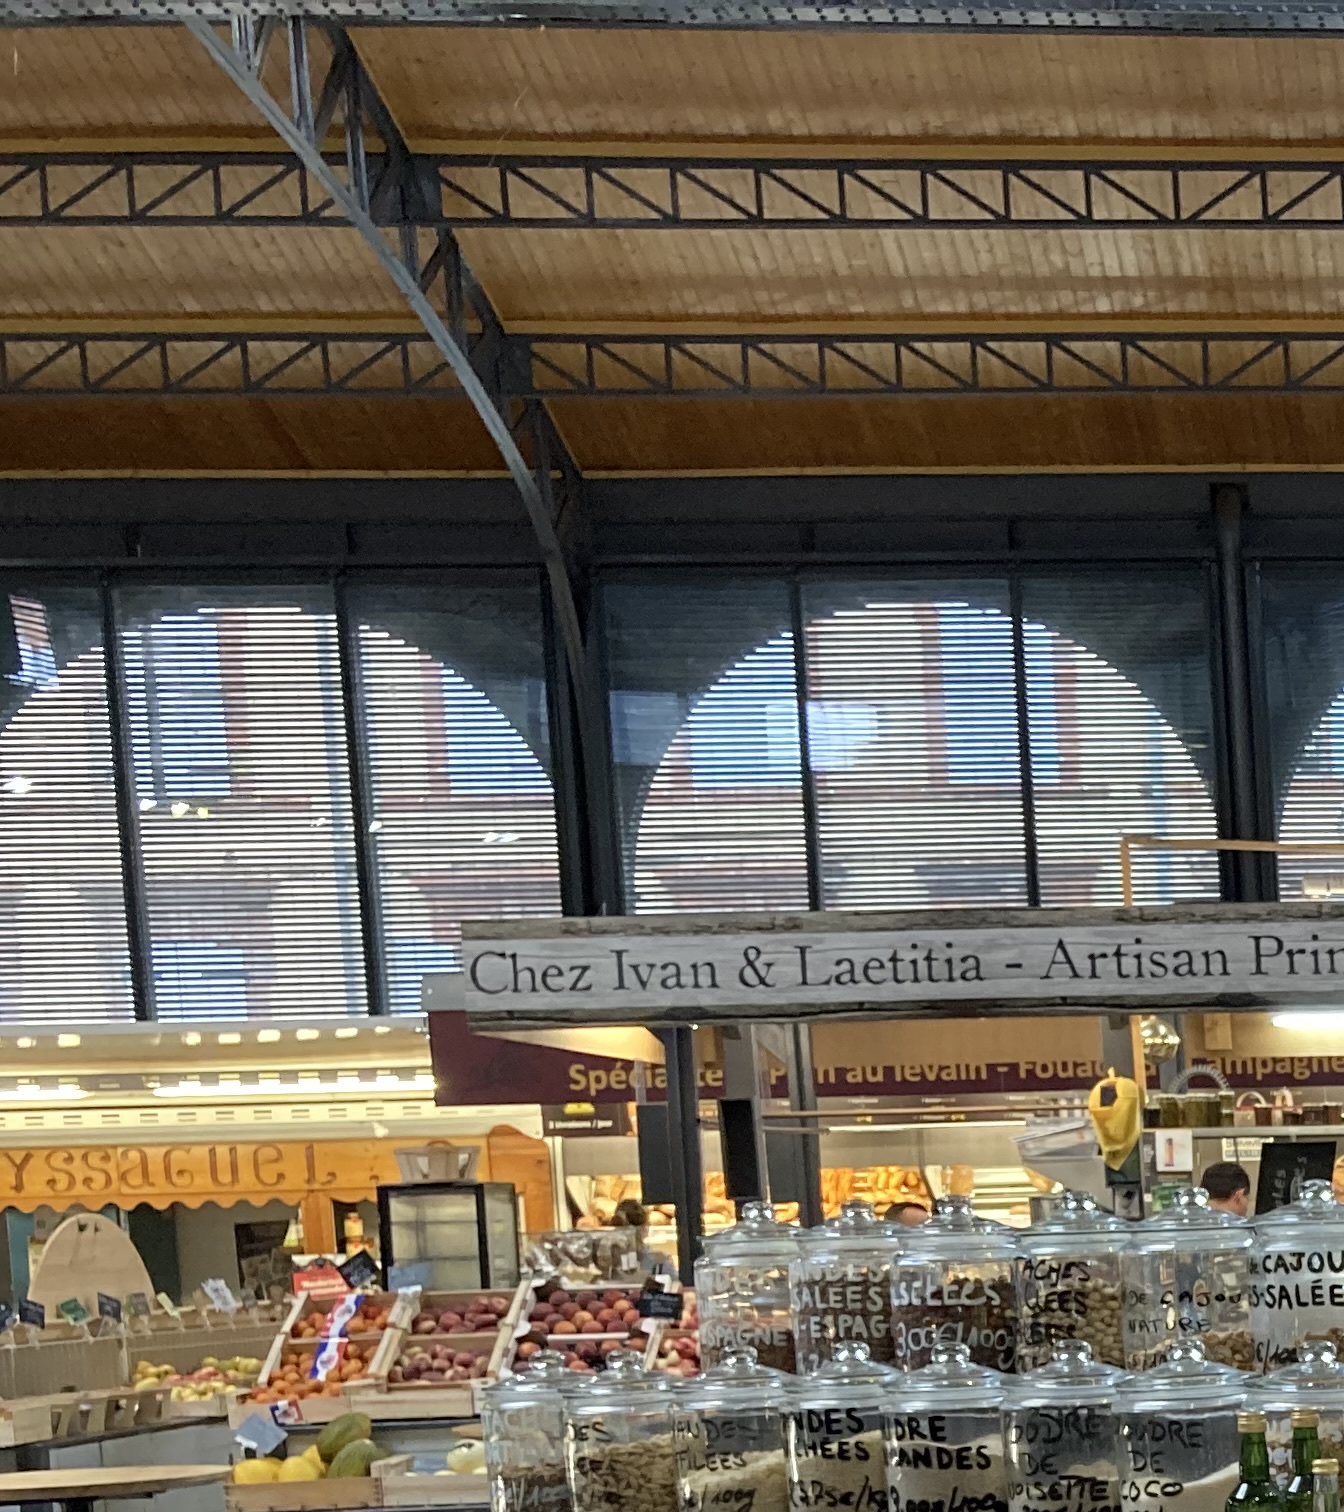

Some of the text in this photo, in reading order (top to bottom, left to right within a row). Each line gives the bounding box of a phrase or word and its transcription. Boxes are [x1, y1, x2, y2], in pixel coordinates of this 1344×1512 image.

[469, 950, 593, 995] Chez
[610, 948, 720, 991] Ivan
[737, 945, 776, 988] &
[794, 941, 985, 987] Laetitia
[1040, 937, 1231, 981] Artisan
[1130, 1450, 1164, 1472] DE
